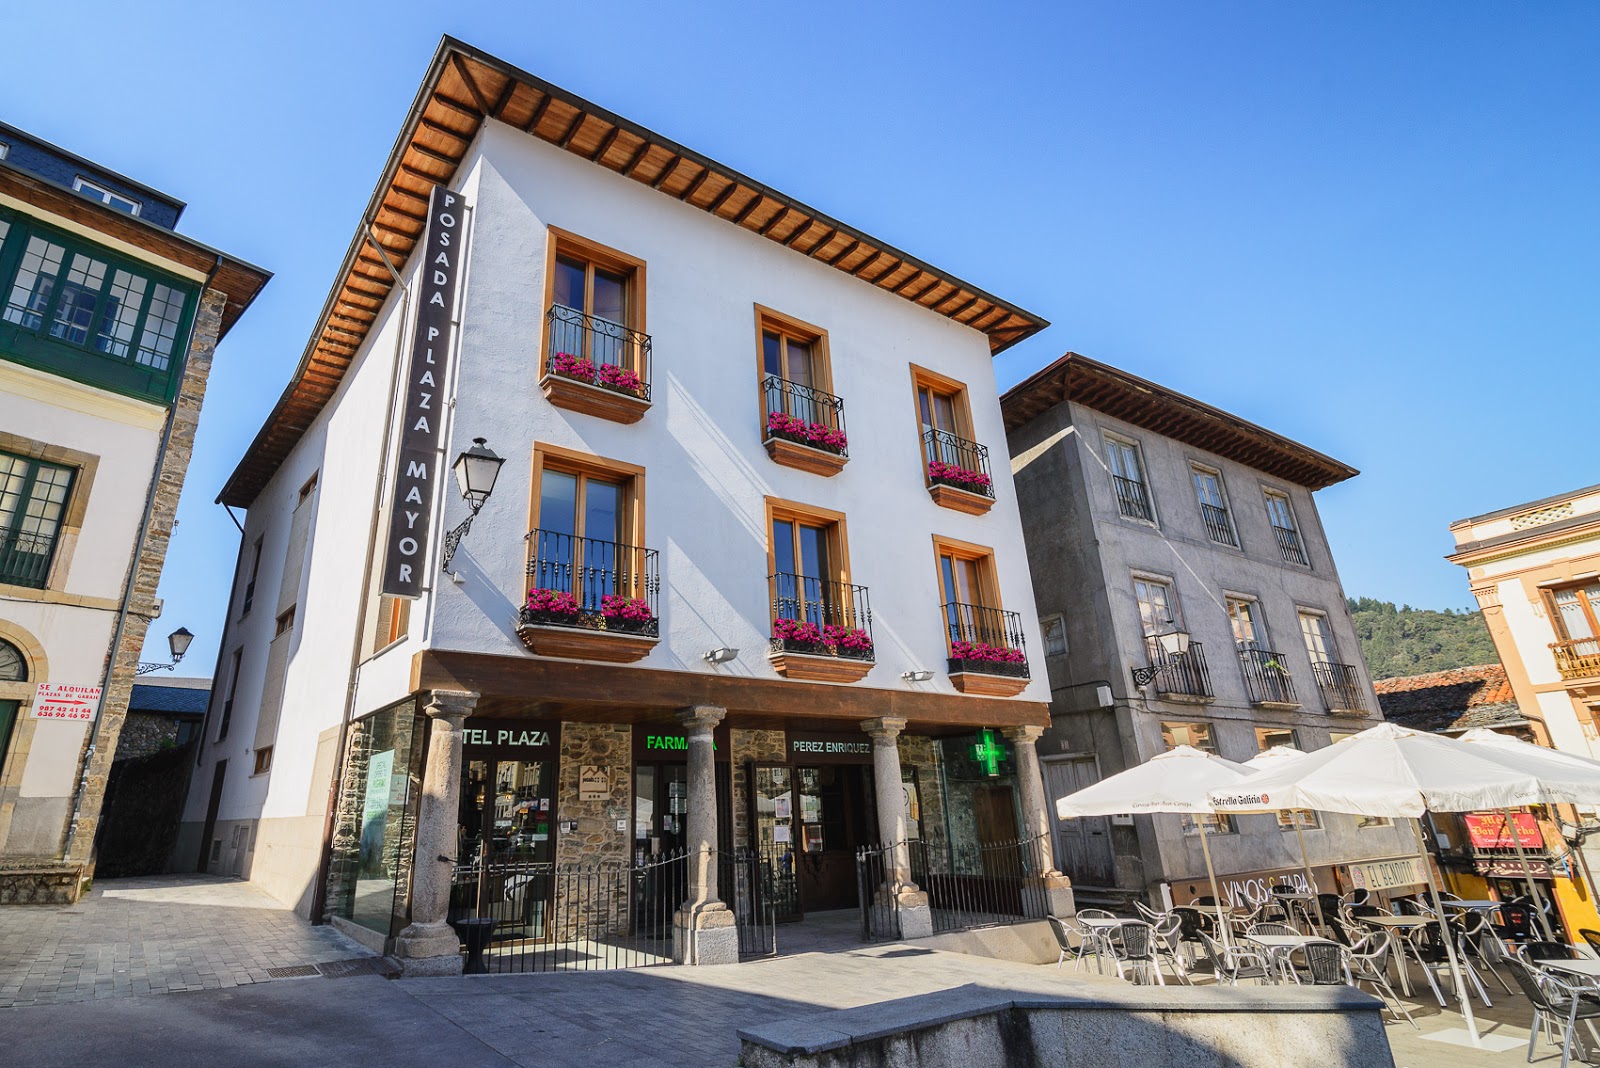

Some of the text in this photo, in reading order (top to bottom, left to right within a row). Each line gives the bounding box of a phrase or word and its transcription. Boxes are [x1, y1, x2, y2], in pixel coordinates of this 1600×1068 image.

[398, 194, 456, 584] POSADA PLAZA MAYOR
[57, 686, 101, 694] ALQUILAN
[462, 728, 551, 746] TEL PLAZA
[793, 740, 871, 754] PEREZ ENRIQUEZ
[1212, 794, 1261, 806] Estrella Galicia
[1472, 825, 1536, 838] Don Ncho
[1367, 861, 1415, 888] EL BENDITO
